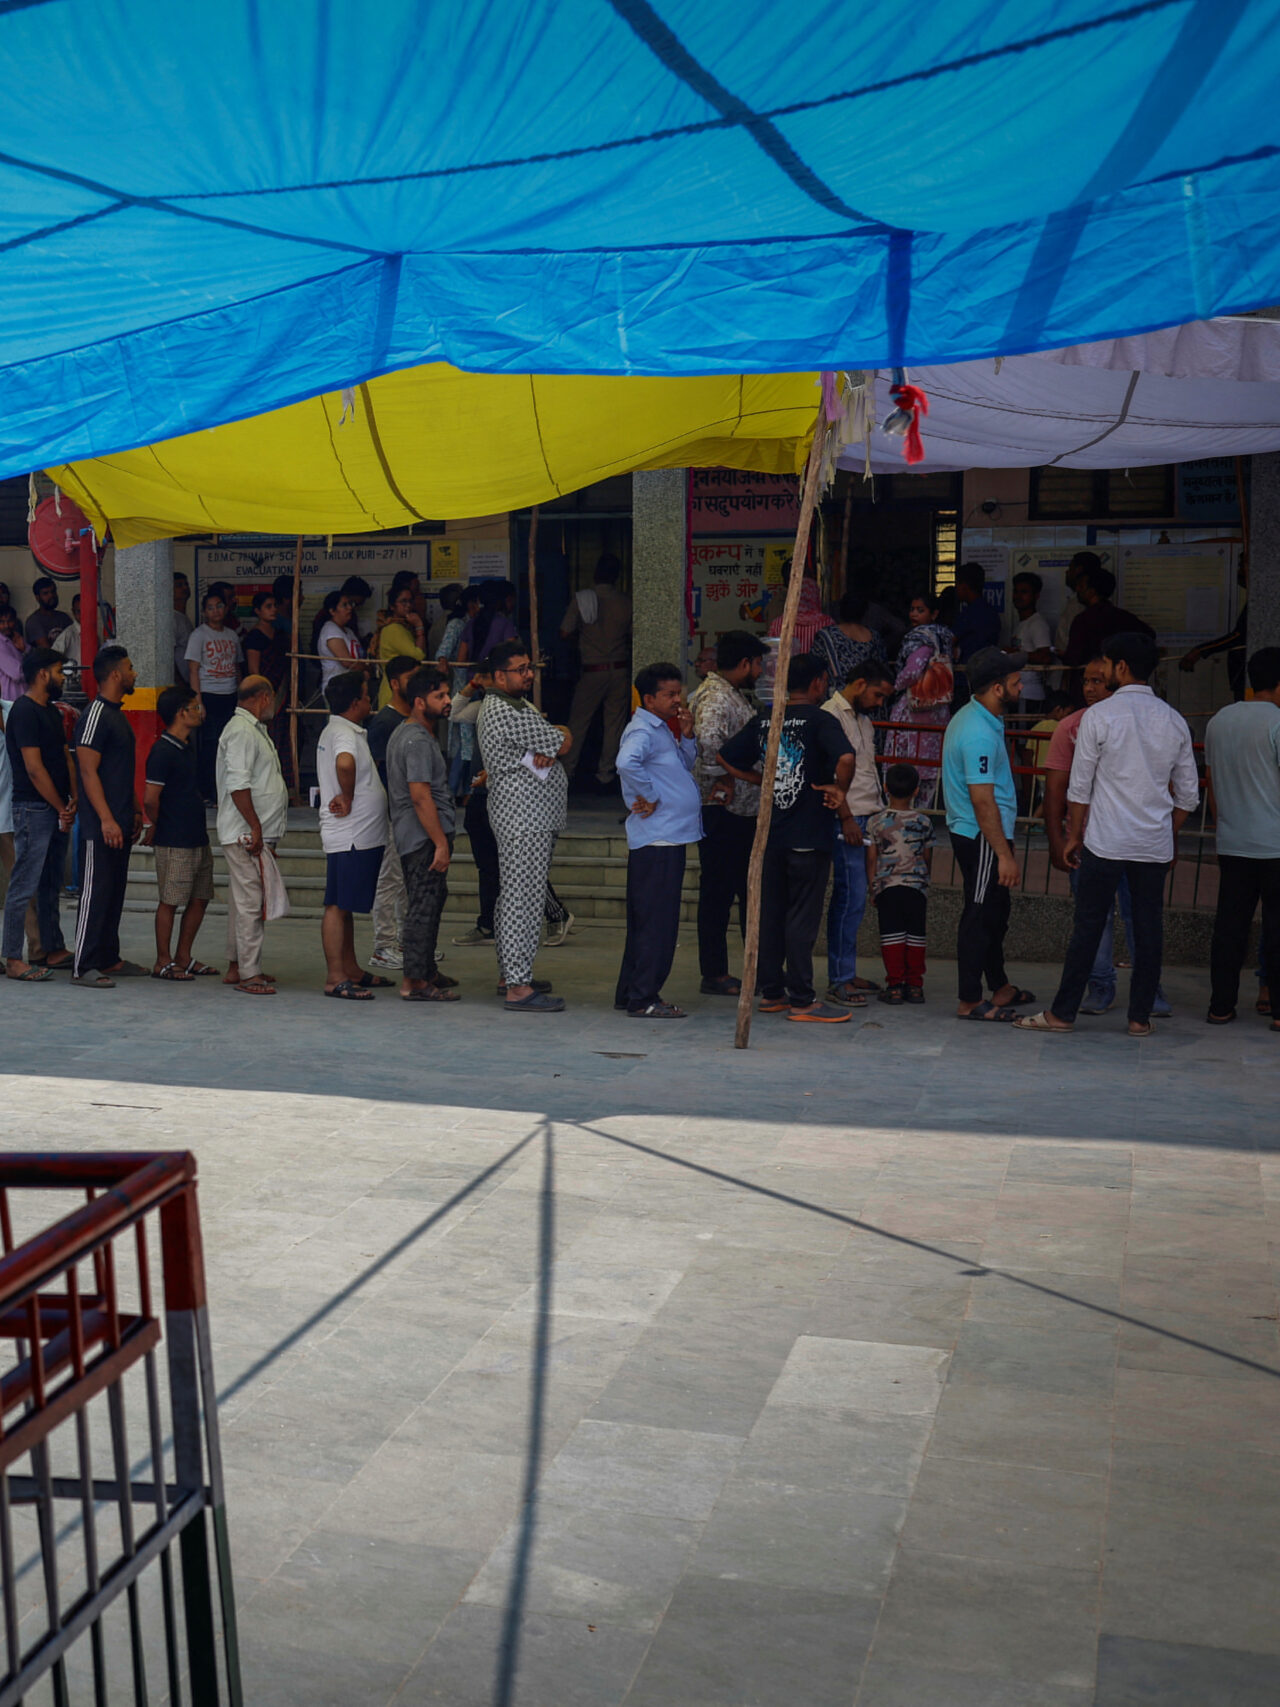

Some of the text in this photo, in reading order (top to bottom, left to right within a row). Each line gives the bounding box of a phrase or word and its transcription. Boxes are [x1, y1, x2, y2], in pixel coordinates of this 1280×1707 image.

[280, 550, 317, 561] SCHOL
[323, 550, 354, 560] TRILOK
[236, 565, 294, 576] EVACUATION
[979, 756, 989, 774] 3
